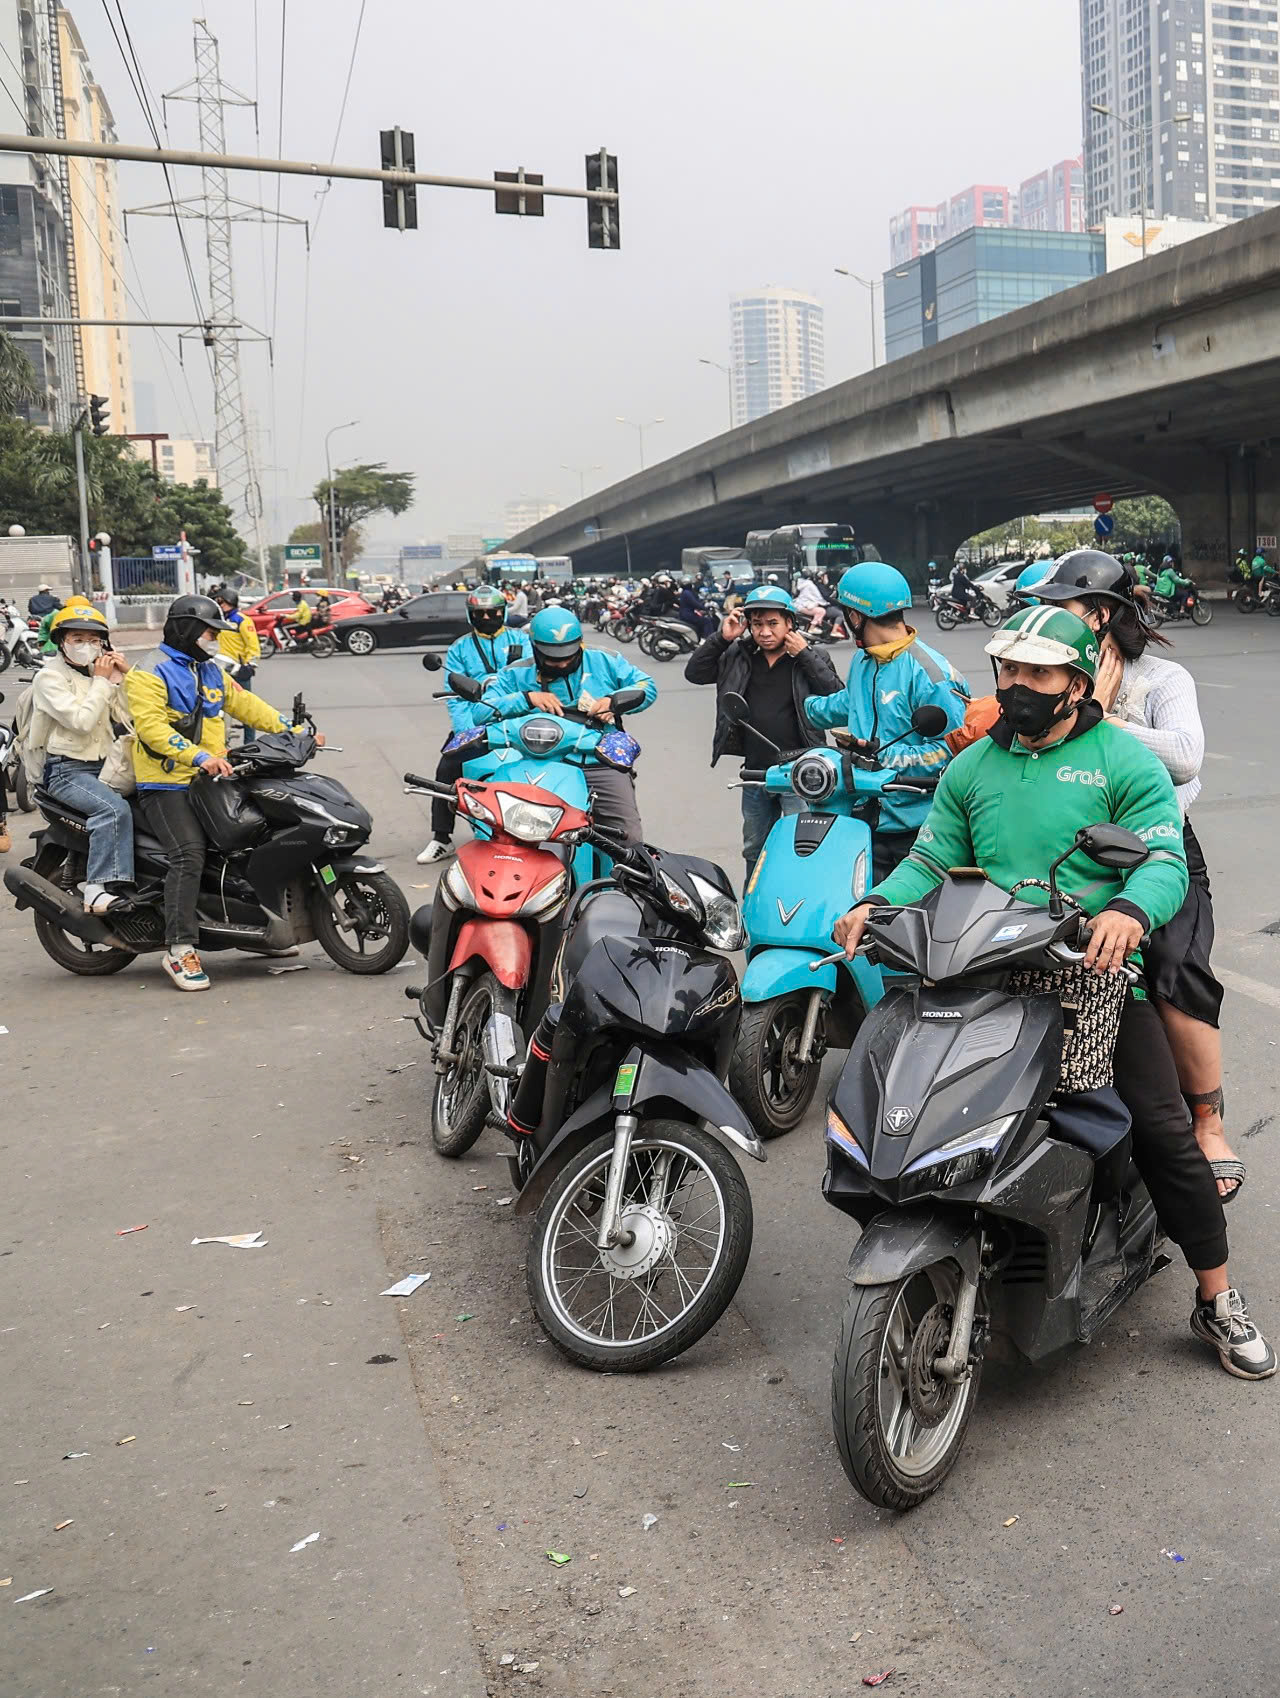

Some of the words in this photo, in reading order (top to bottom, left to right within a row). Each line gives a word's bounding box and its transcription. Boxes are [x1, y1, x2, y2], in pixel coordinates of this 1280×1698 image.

[1056, 766, 1107, 788] Grab
[800, 818, 828, 826] VINFAST
[493, 854, 523, 863] HONDA
[654, 946, 691, 959] HONDA
